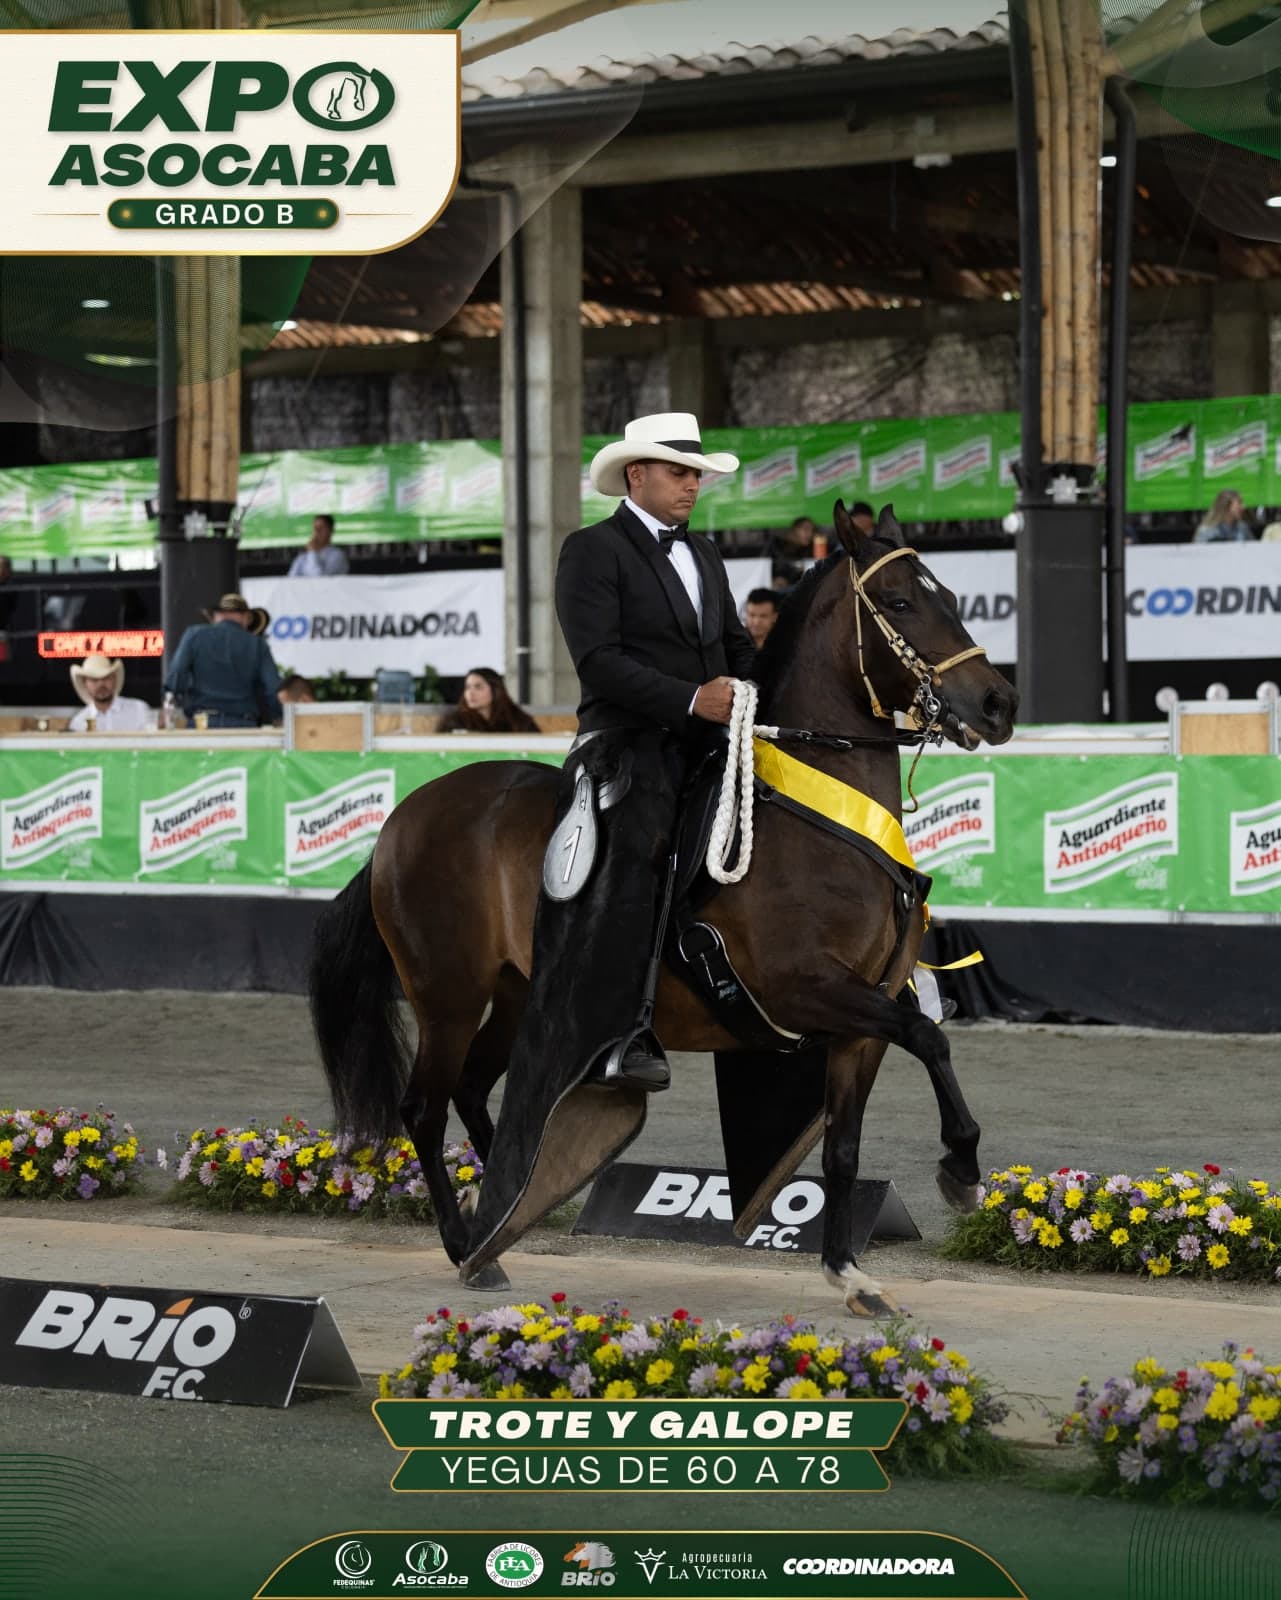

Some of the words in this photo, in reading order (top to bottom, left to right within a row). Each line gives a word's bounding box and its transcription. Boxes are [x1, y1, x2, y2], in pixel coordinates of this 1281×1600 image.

[265, 611, 480, 641] OORDINADORA
[12, 803, 93, 849] Antioqueño
[13, 789, 92, 831] Aguardiente
[150, 804, 237, 852] Antioqueño
[152, 791, 236, 833] Aguardiente
[297, 793, 384, 835] Aguardiente
[1058, 798, 1166, 848] Aguardiente
[562, 826, 582, 883] 1
[1056, 815, 1167, 869] Antioqueño
[633, 1172, 826, 1226] BRO
[744, 1225, 800, 1249] F.C.
[142, 1366, 206, 1401] F.C.
